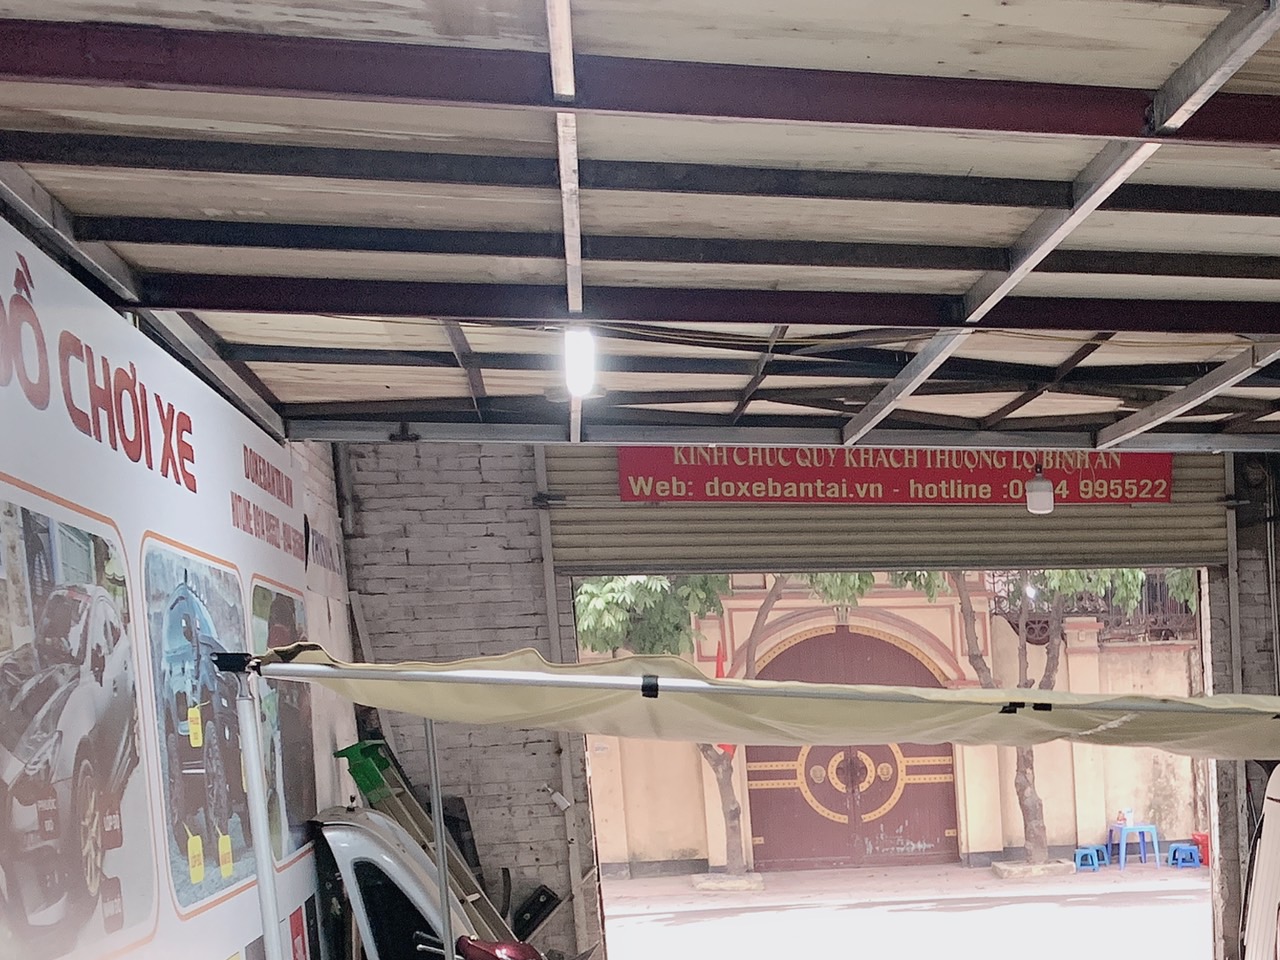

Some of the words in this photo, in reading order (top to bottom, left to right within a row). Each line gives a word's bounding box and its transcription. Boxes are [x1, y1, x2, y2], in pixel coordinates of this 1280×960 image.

[0, 251, 50, 411] Ồ
[59, 330, 154, 471] CHƠI
[154, 392, 198, 494] XE
[628, 475, 694, 497] Web:
[705, 477, 883, 499] doxebantai.vn
[910, 478, 992, 499] hotline
[1003, 479, 1069, 499] :04
[1079, 479, 1167, 499] 995522
